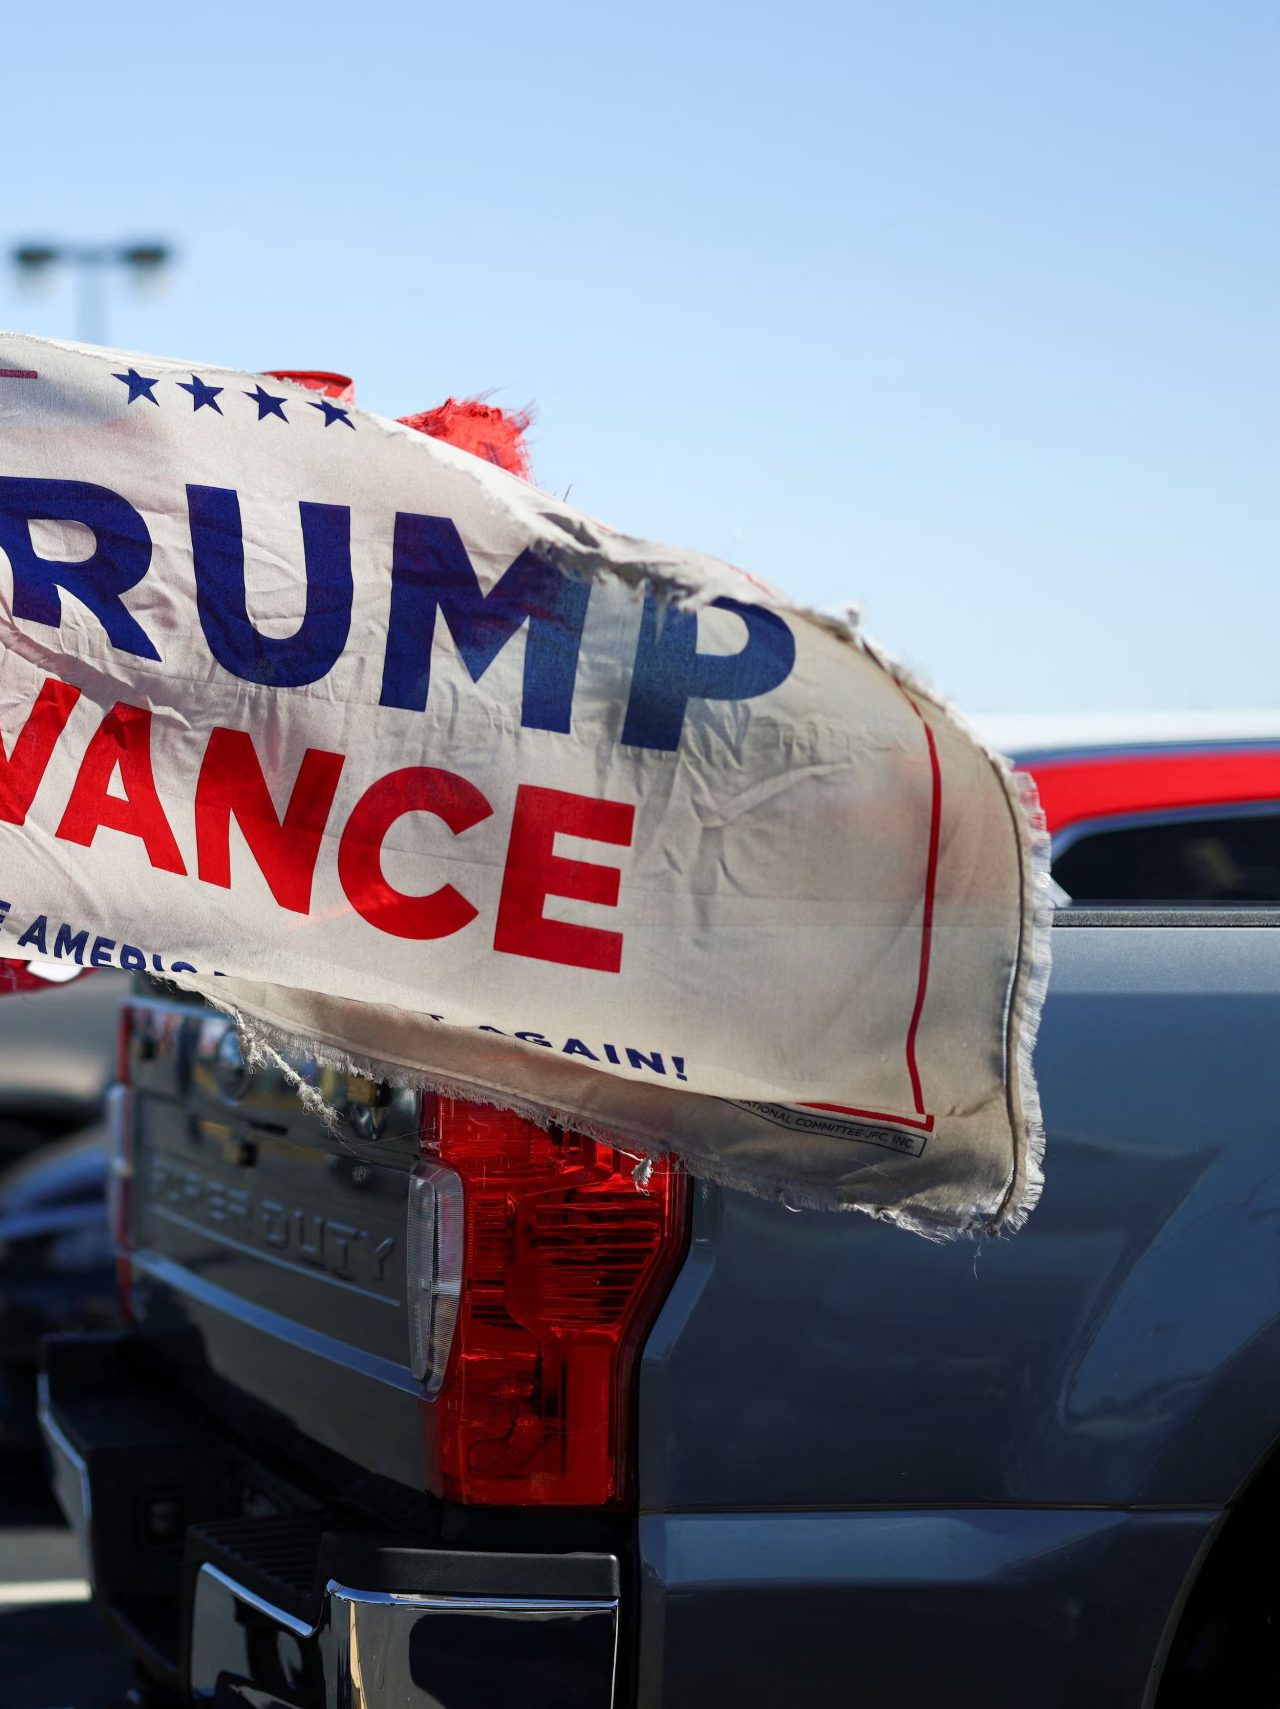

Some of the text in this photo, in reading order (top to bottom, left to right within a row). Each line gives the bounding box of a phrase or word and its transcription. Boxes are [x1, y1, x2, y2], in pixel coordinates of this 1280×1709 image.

[16, 914, 228, 977] AMERI
[739, 1100, 792, 1124] ATIONAL
[795, 1116, 864, 1138] COMMITTEE
[891, 1134, 915, 1149] INC.
[260, 1199, 397, 1281] DUTY
